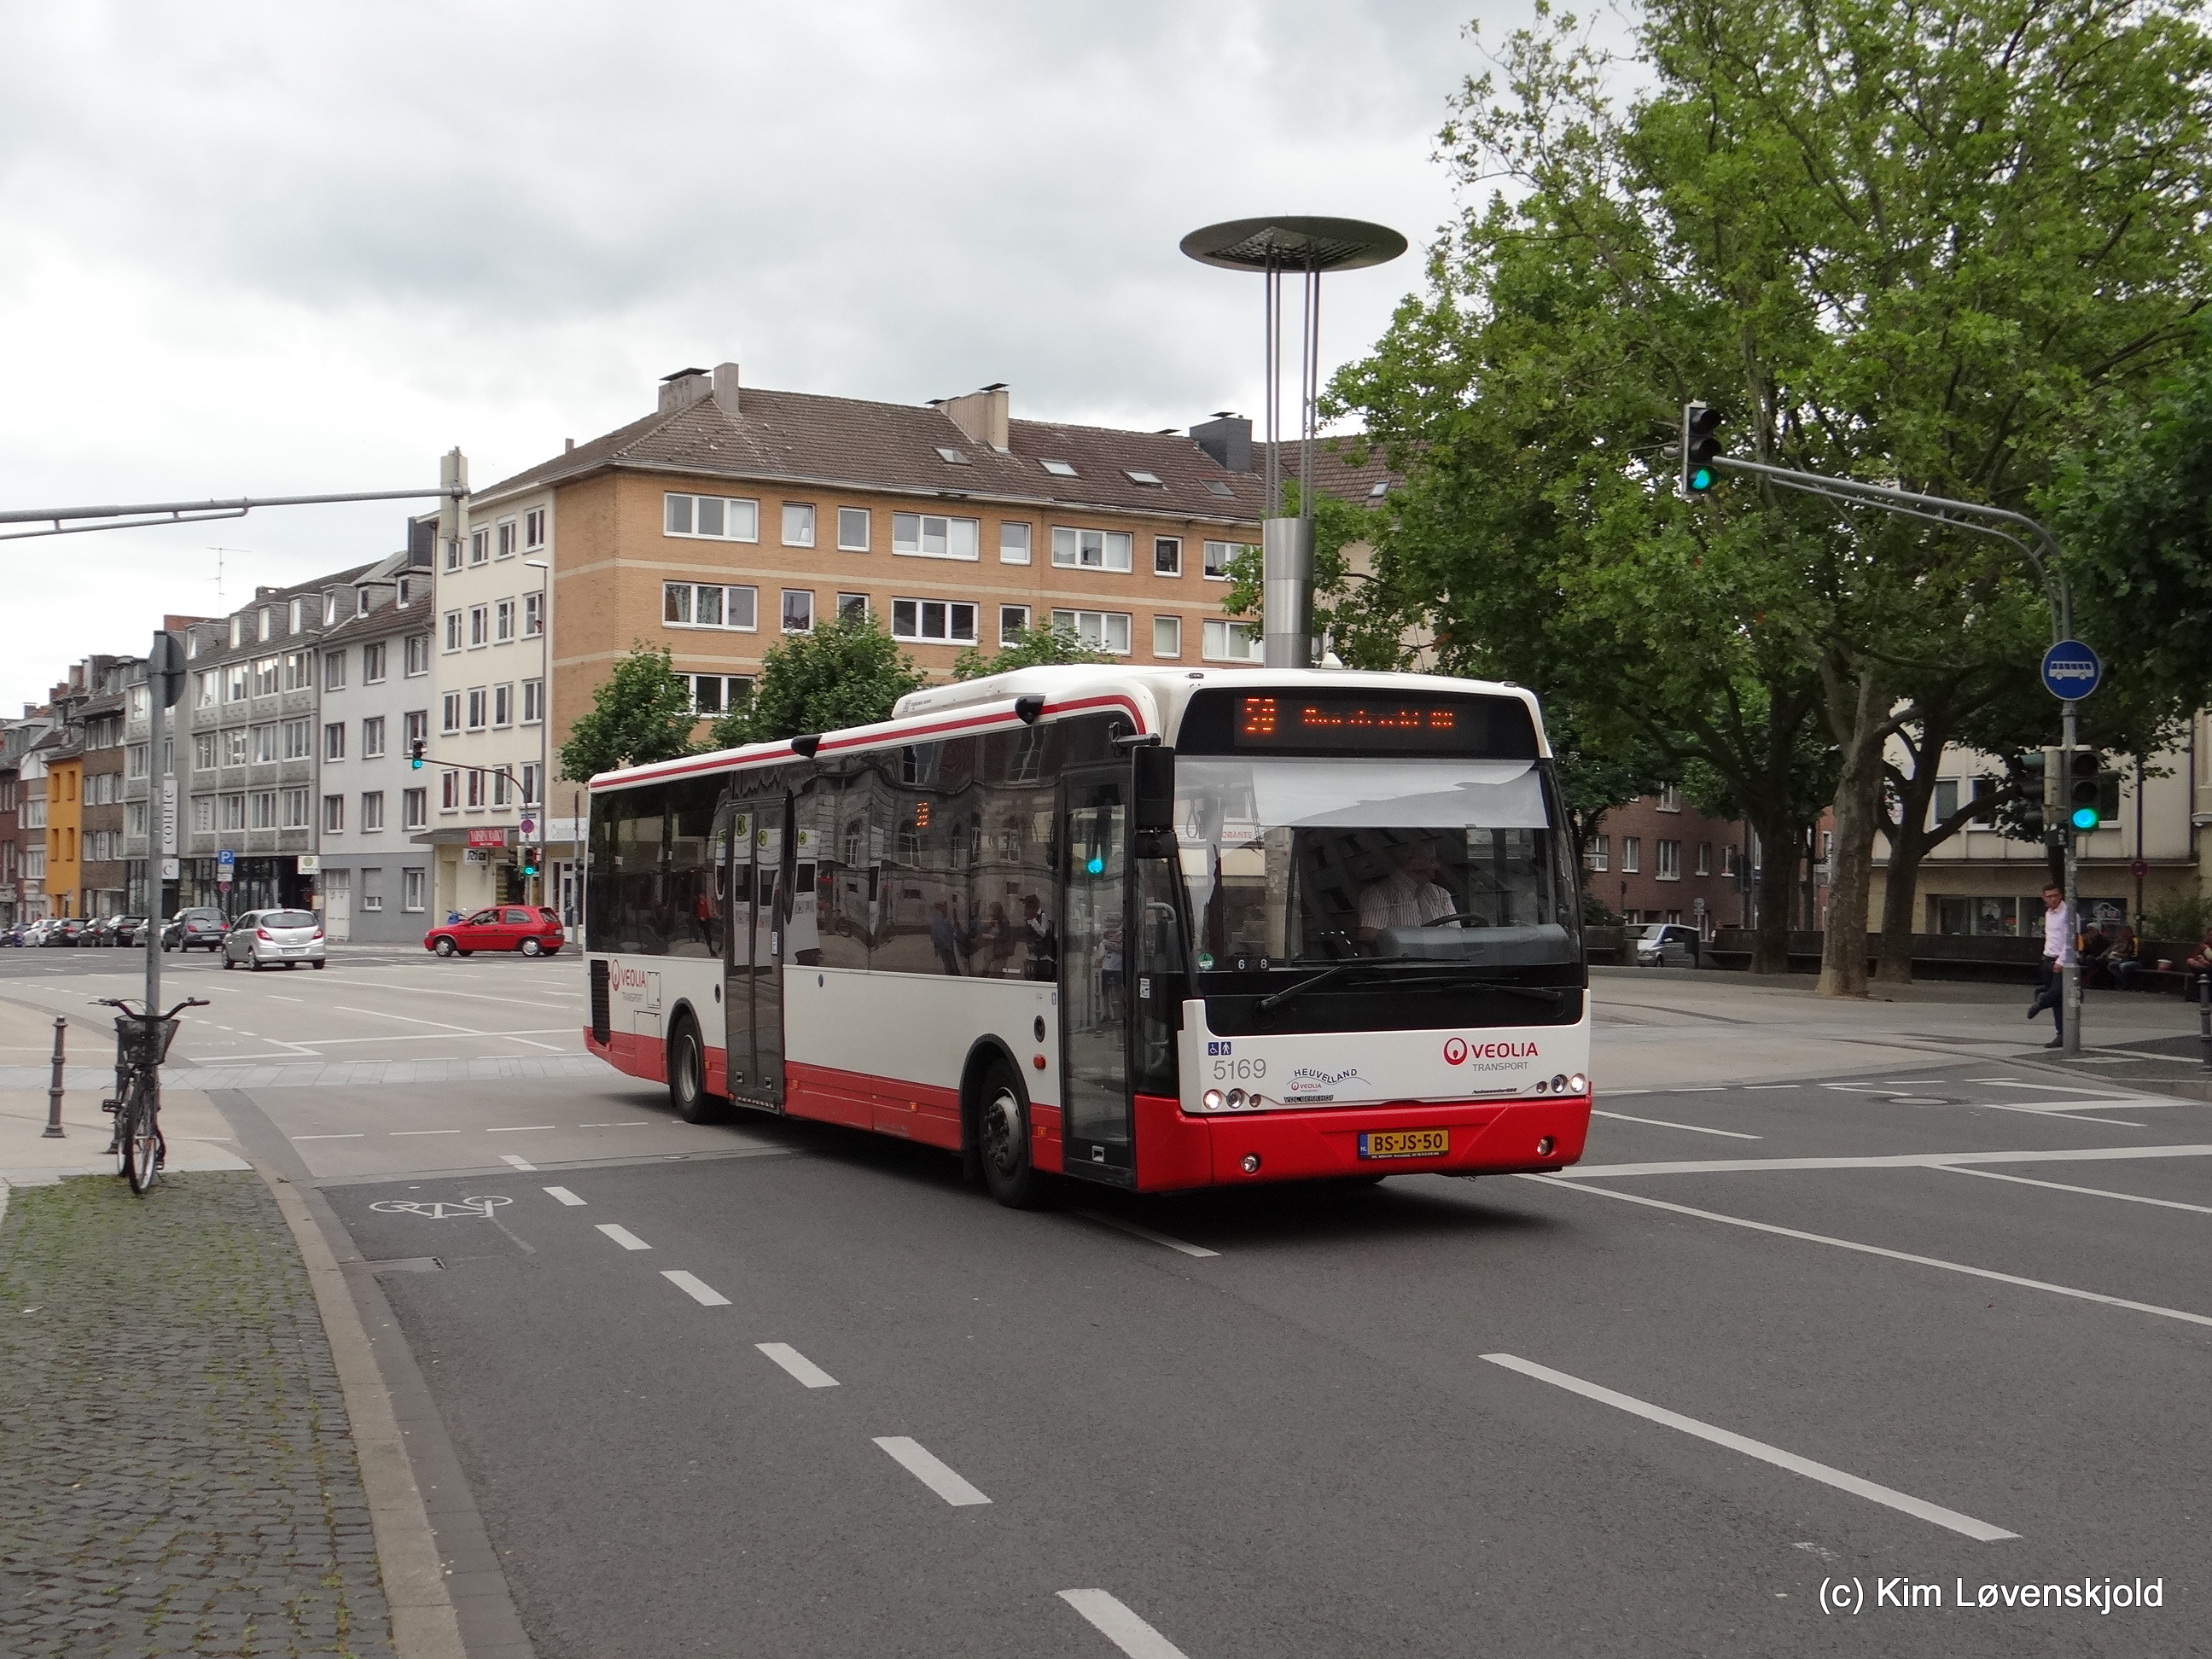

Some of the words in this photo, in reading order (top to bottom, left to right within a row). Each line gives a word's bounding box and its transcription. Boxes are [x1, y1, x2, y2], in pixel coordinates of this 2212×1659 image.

[1237, 959, 1245, 969] 6
[1260, 958, 1267, 969] 8
[620, 969, 646, 987] VEOLIA
[1471, 1042, 1539, 1059] VEOLIA
[1213, 1058, 1266, 1080] 5169
[1472, 1062, 1528, 1071] TRANSPORT
[1294, 1068, 1358, 1084] HEUVELLAND
[1374, 1132, 1443, 1152] BS-JS-50
